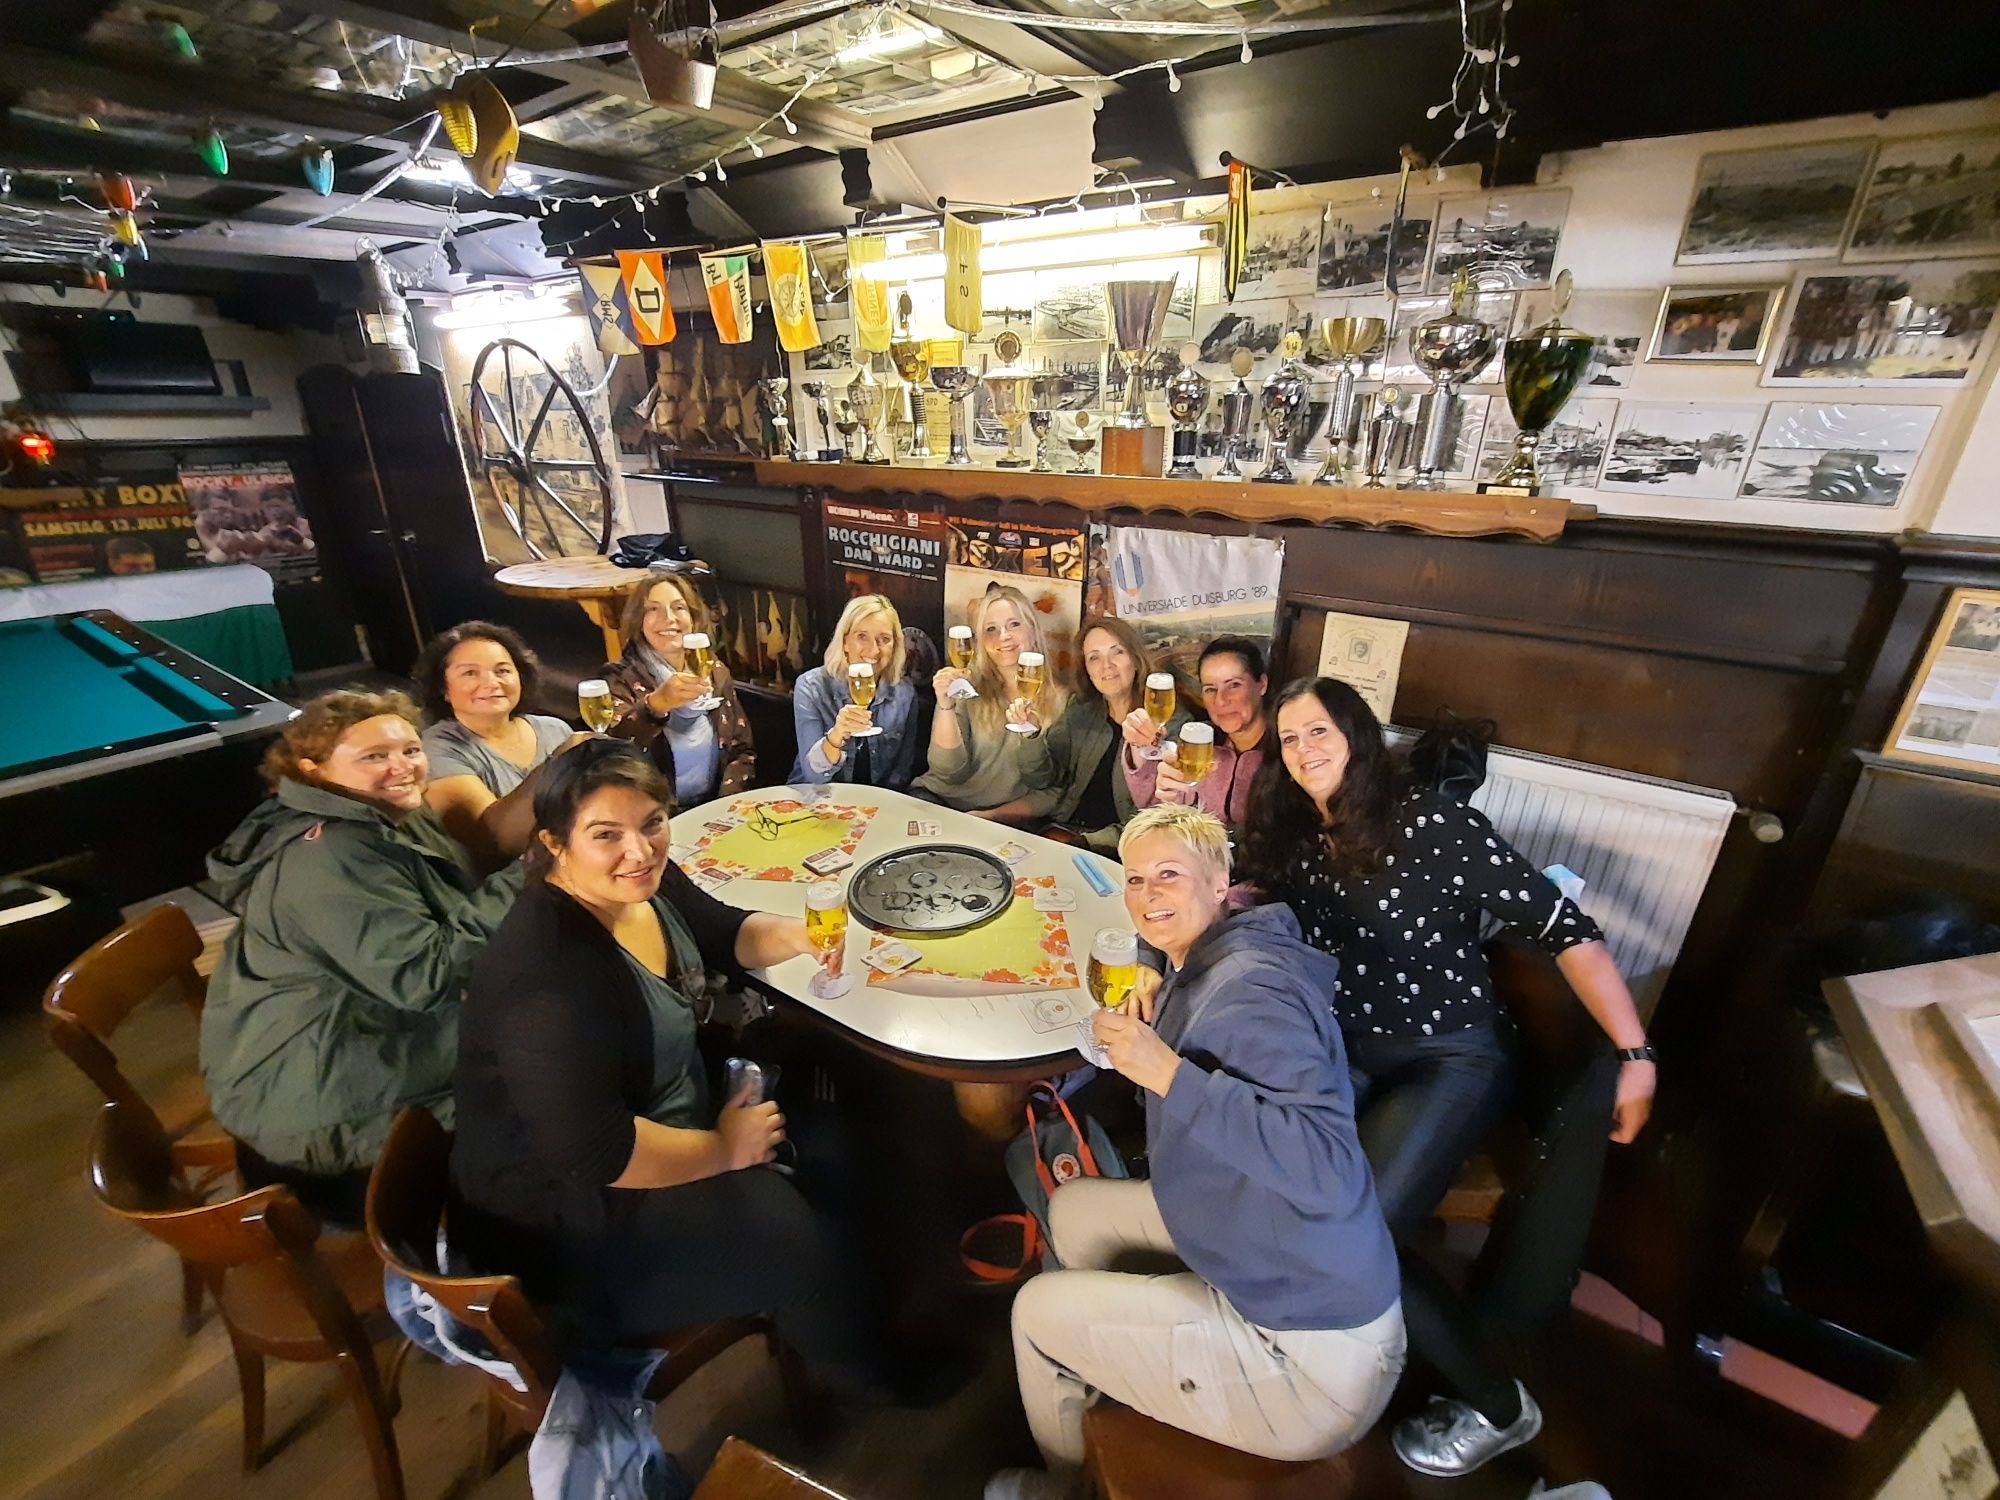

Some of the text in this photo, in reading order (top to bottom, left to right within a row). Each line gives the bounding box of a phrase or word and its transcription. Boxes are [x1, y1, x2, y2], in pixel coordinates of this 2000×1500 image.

[634, 287, 661, 313] D
[828, 526, 941, 557] ROCCHIGIANI
[844, 546, 873, 562] DAN
[877, 552, 923, 570] WARD
[1123, 585, 1268, 615] UNIVERSIADE DUISBURG '89
